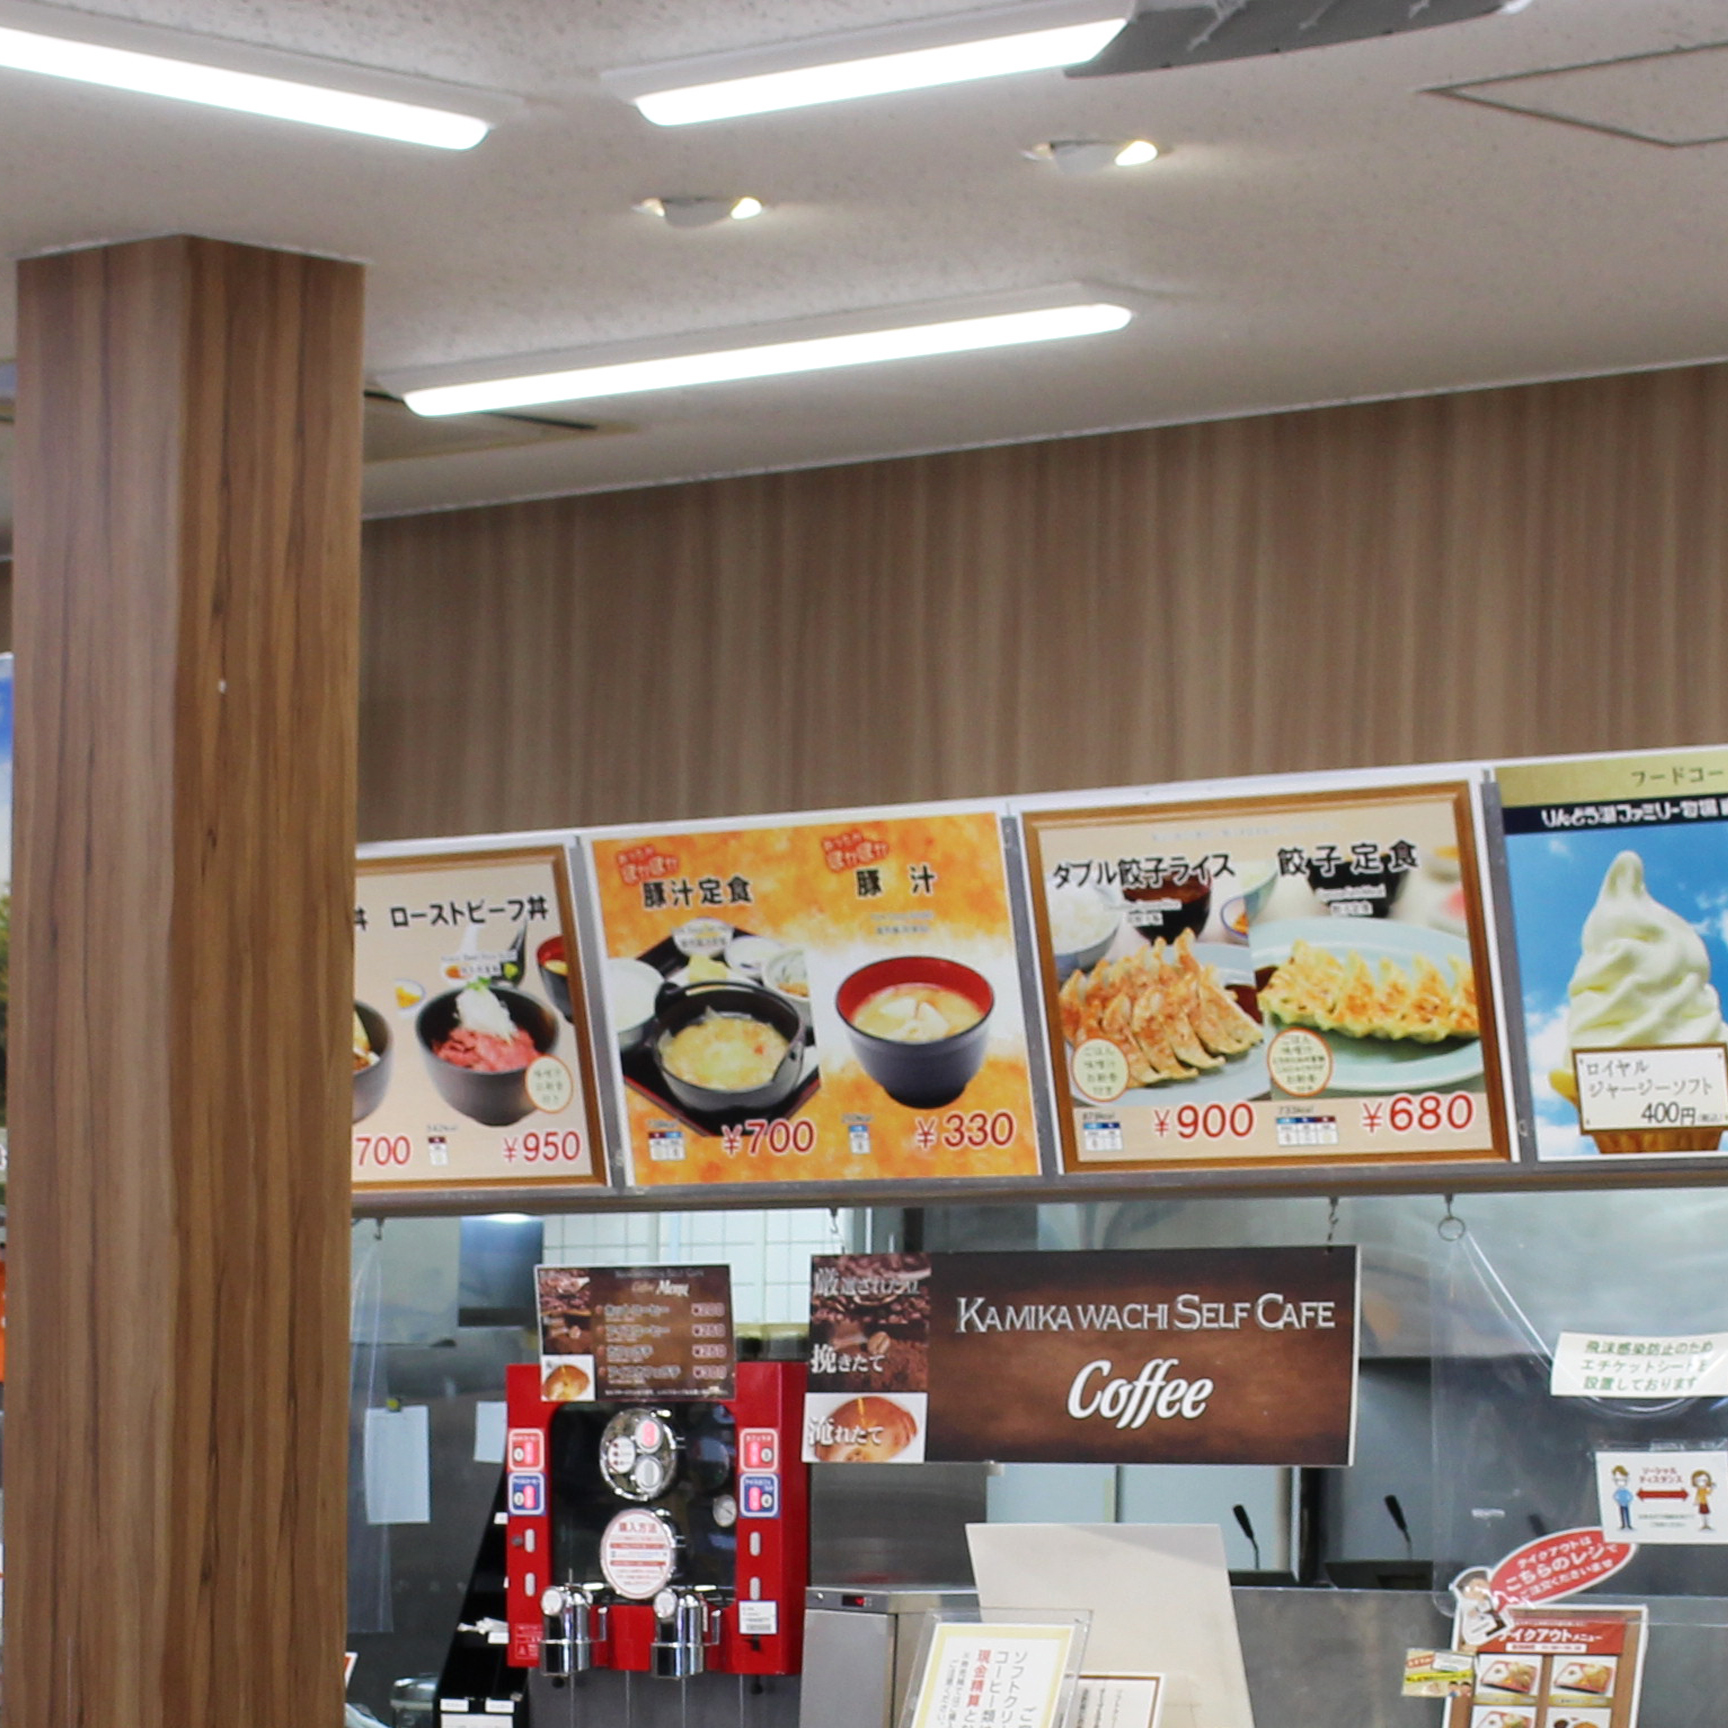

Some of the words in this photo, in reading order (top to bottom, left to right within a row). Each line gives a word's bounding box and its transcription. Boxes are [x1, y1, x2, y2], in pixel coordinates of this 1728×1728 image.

[1052, 853, 1237, 890] ダブル餃子ライス
[1277, 839, 1419, 878] 餃子定食
[642, 876, 754, 909] 豚汁定食
[854, 865, 936, 898] 豚汁
[390, 896, 551, 928] ローストビーフ丼
[1585, 1058, 1650, 1077] ロイヤル
[1587, 1077, 1714, 1099] ジャージーソフト
[916, 1111, 1016, 1150] ¥330
[1152, 1102, 1256, 1140] ¥900
[1362, 1094, 1474, 1134] ¥680
[502, 1131, 582, 1164] ¥950
[722, 1119, 816, 1157] ¥700
[1067, 1357, 1214, 1430] Coffee
